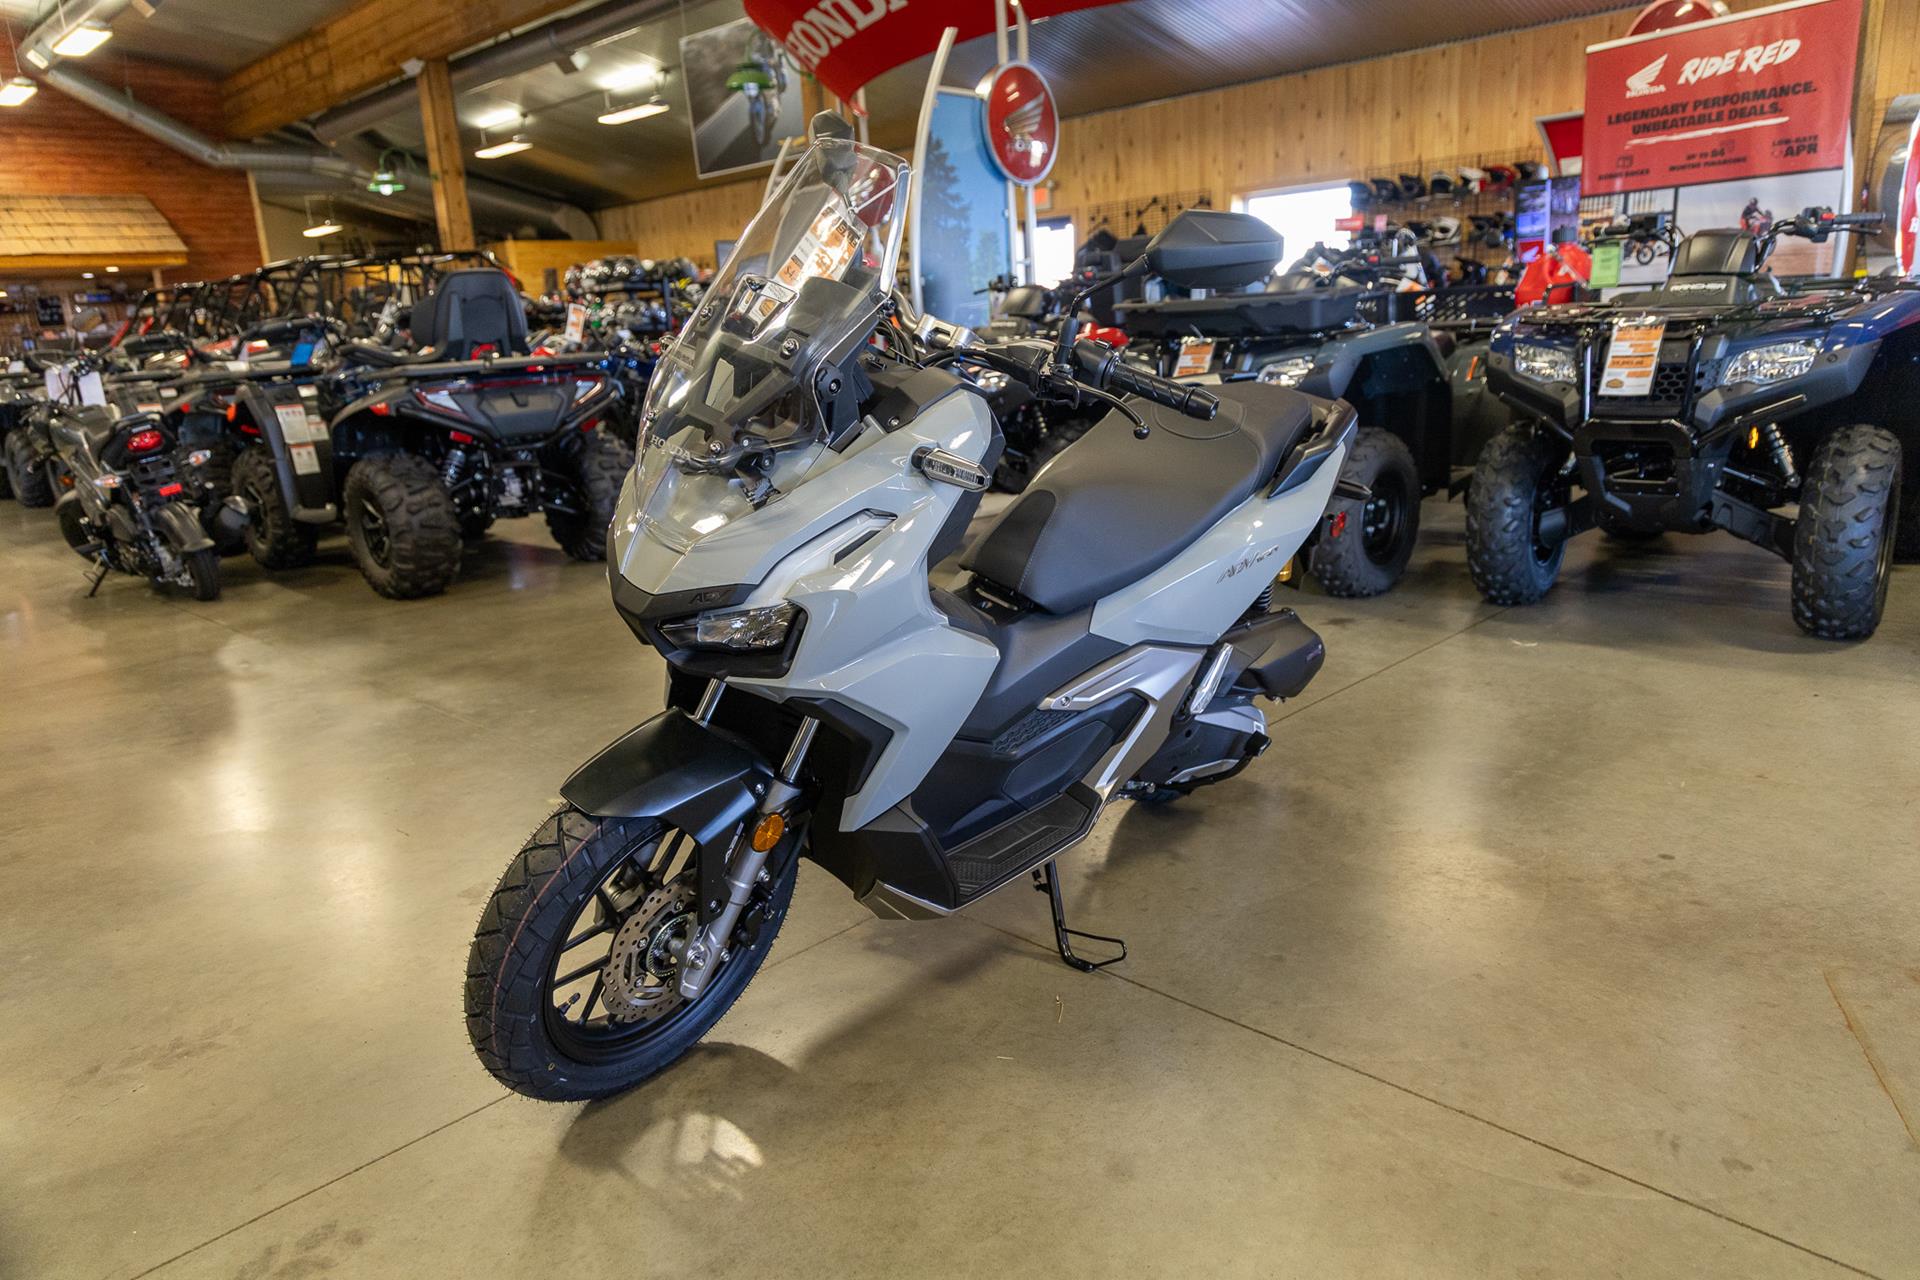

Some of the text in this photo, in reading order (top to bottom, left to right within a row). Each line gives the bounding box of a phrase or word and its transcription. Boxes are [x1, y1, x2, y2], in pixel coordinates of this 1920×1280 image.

[785, 0, 909, 69] HOND
[1677, 38, 1801, 86] RIDE RED
[1607, 81, 1818, 126] LEGENDARY PERFORMANCE.
[1632, 101, 1784, 135] UNBEATABLE DEALS.
[1783, 142, 1818, 158] APR
